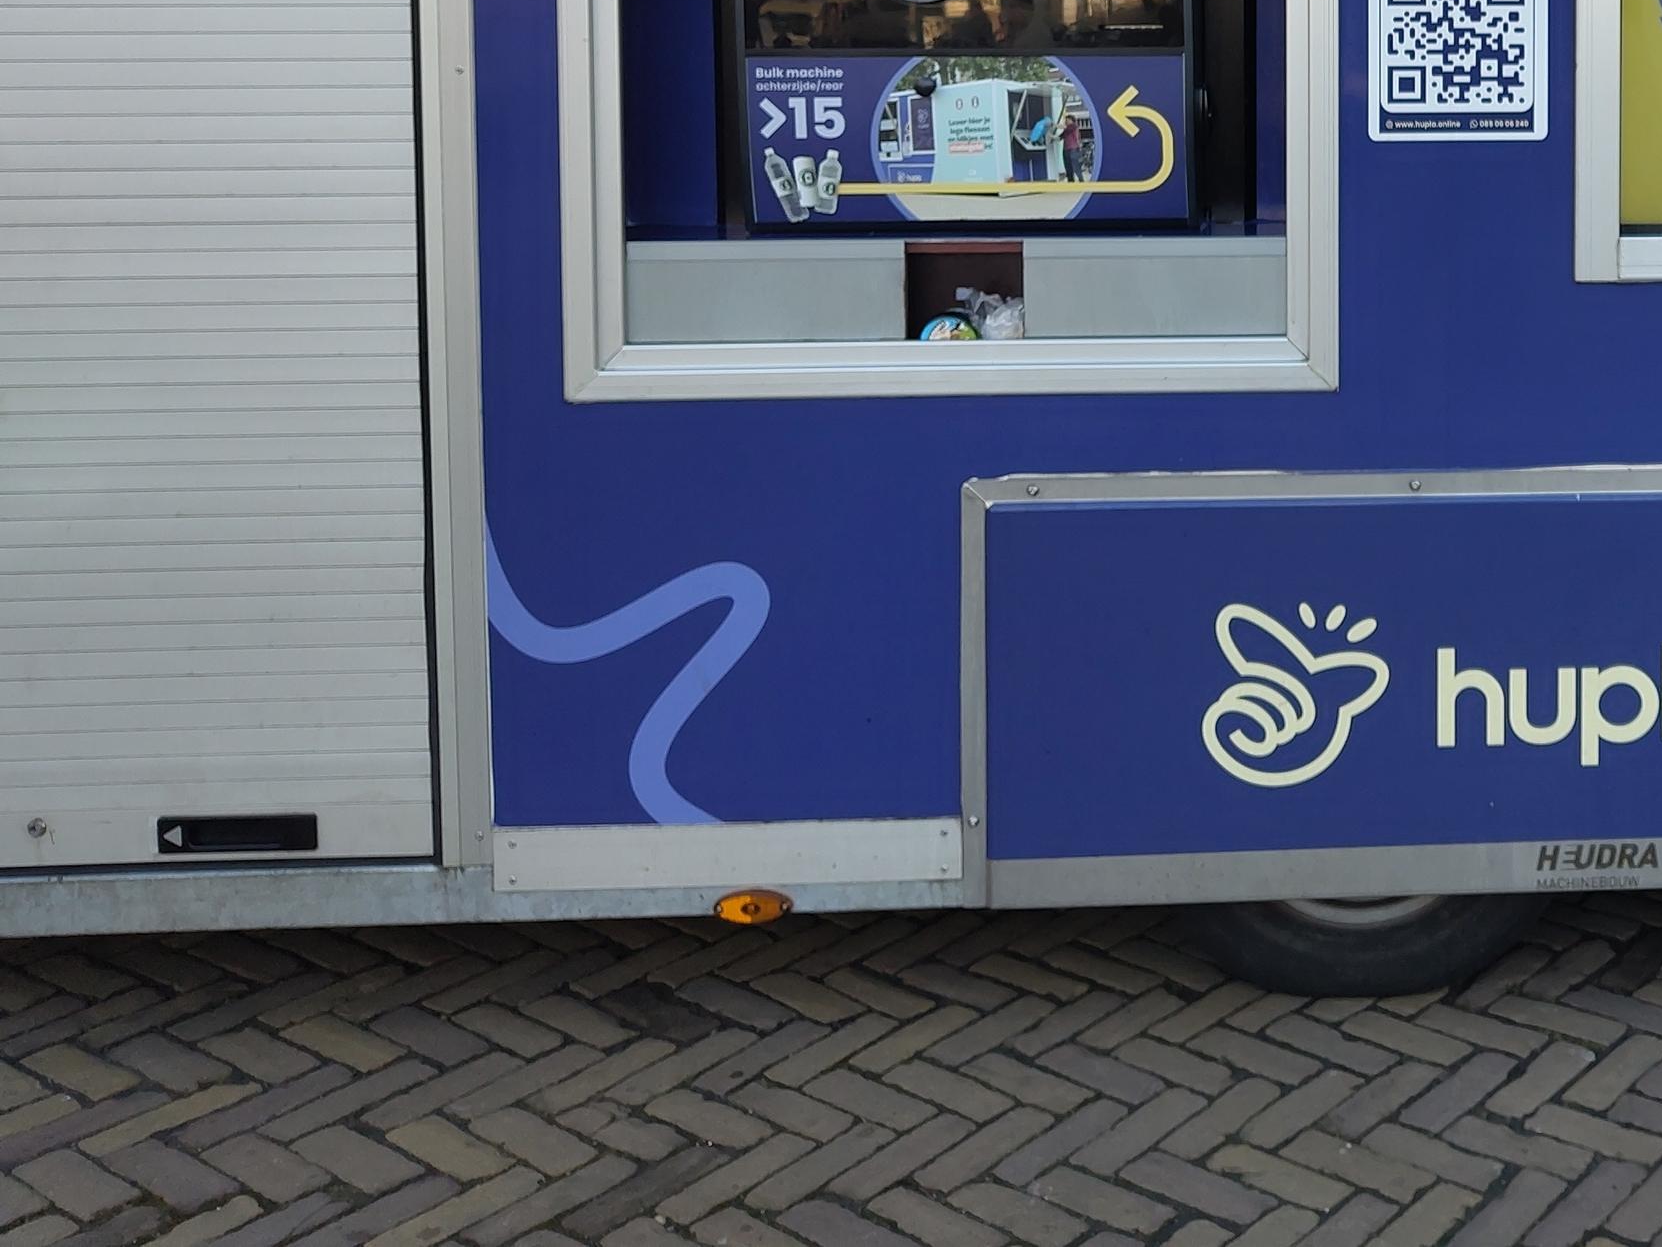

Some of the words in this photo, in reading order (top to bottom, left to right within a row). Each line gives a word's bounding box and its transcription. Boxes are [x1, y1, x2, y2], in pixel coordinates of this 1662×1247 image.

[755, 66, 784, 79] Bulk
[786, 65, 844, 79] machine
[755, 79, 844, 94] achterzijde/rear
[759, 97, 846, 140] >15
[1536, 842, 1660, 871] HEUDRA
[1536, 874, 1641, 890] MACHINEBOUW
